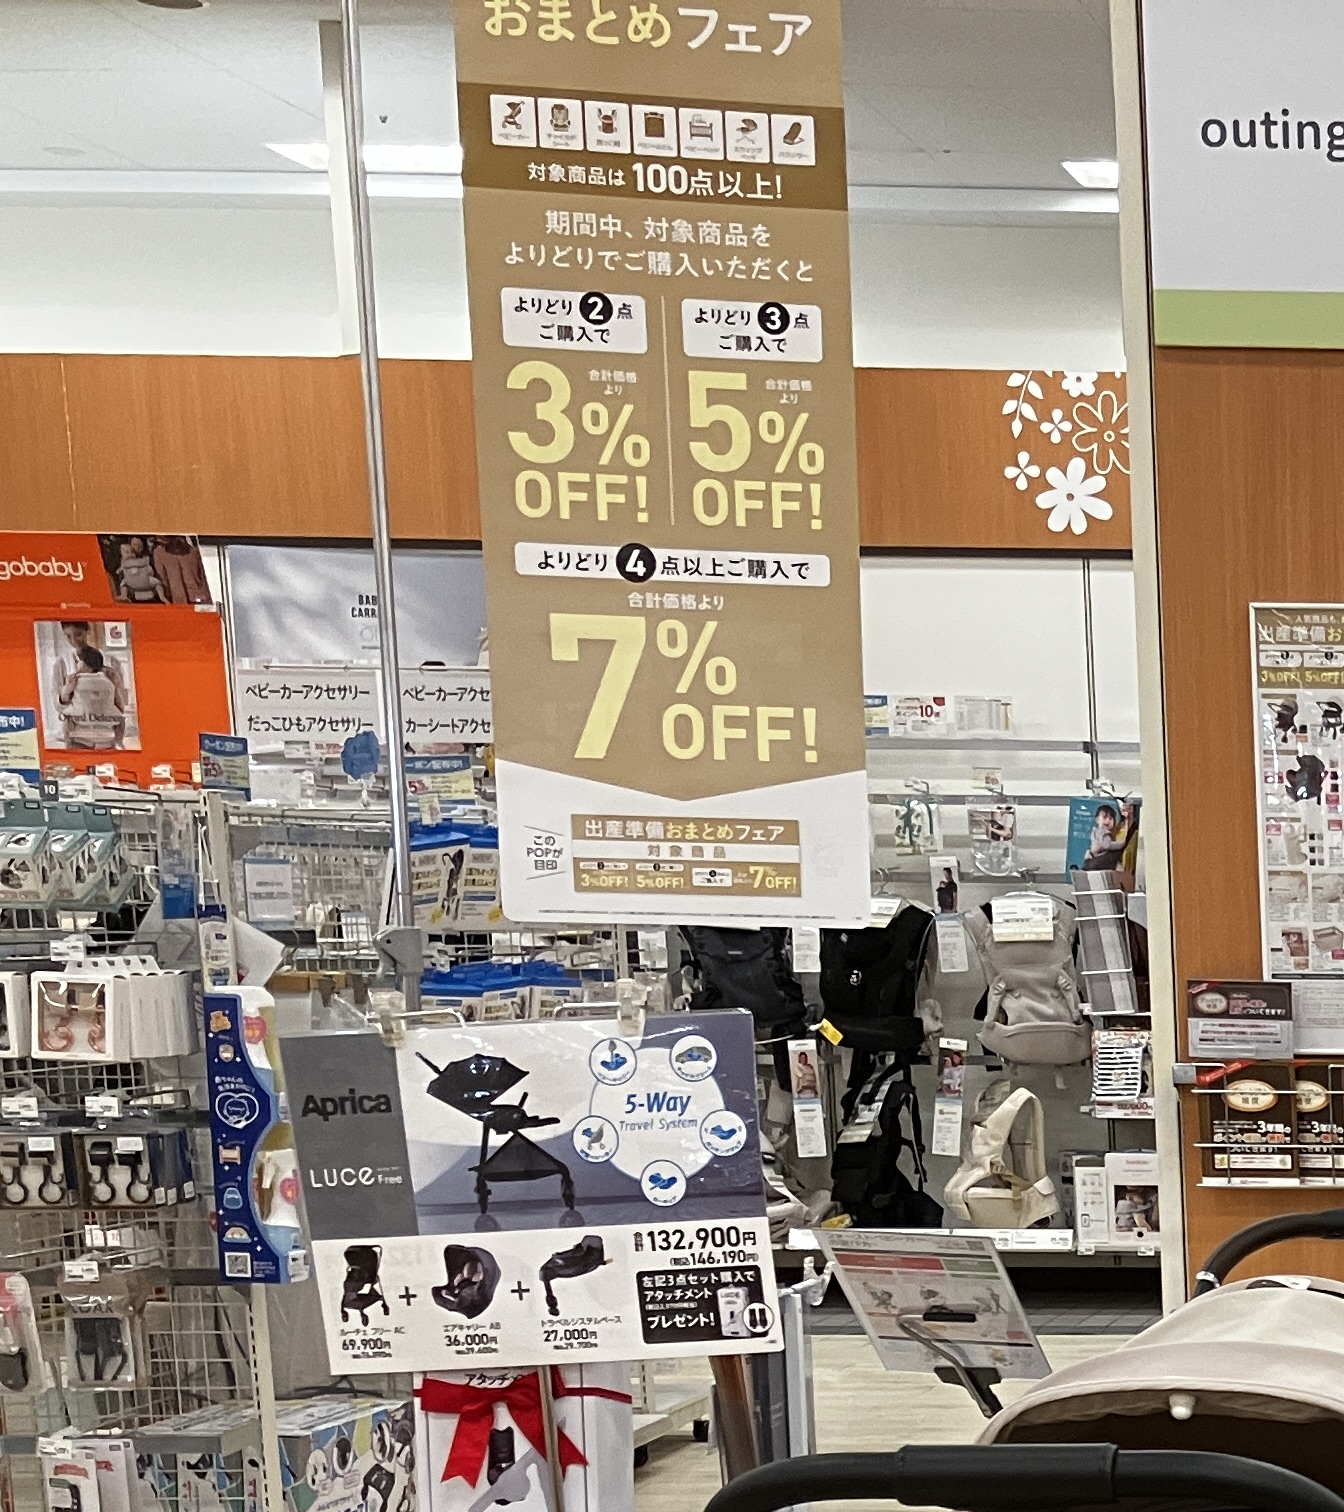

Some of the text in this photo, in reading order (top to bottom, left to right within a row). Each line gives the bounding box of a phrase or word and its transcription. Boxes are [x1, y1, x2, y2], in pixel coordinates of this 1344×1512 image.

[485, 0, 813, 56] おまとめフェア
[545, 209, 772, 249] 期間中、対象商品を
[503, 240, 815, 283] よりどりでご購入いただくと
[537, 325, 611, 346] ご購入で
[718, 334, 788, 354] ご購入で
[506, 360, 651, 468] 3%
[687, 370, 825, 475] 5%
[515, 470, 649, 523] OFF!
[692, 478, 822, 530] OFF!
[628, 591, 725, 611] 合計価格より
[245, 683, 370, 700] ベビーカーアクセサリー
[402, 685, 490, 702] ベビーカーアクセ
[549, 612, 737, 759] 7%
[247, 715, 374, 732] だっこひもアクセサリー
[405, 717, 490, 734] カーシートアクセ
[662, 703, 819, 763] OFF!
[585, 818, 785, 842] 出産準備おまとめフェア
[301, 1089, 393, 1121] Aprica
[625, 1090, 691, 1117] 5-Way
[619, 1116, 698, 1132] Travel System
[376, 1172, 404, 1186] Free
[647, 1226, 757, 1252] 132,900円
[643, 1288, 713, 1303] アタッチメント
[648, 1312, 716, 1330] プレゼント!
[445, 1333, 498, 1347] 36,000円
[543, 1328, 597, 1343] 27,000円
